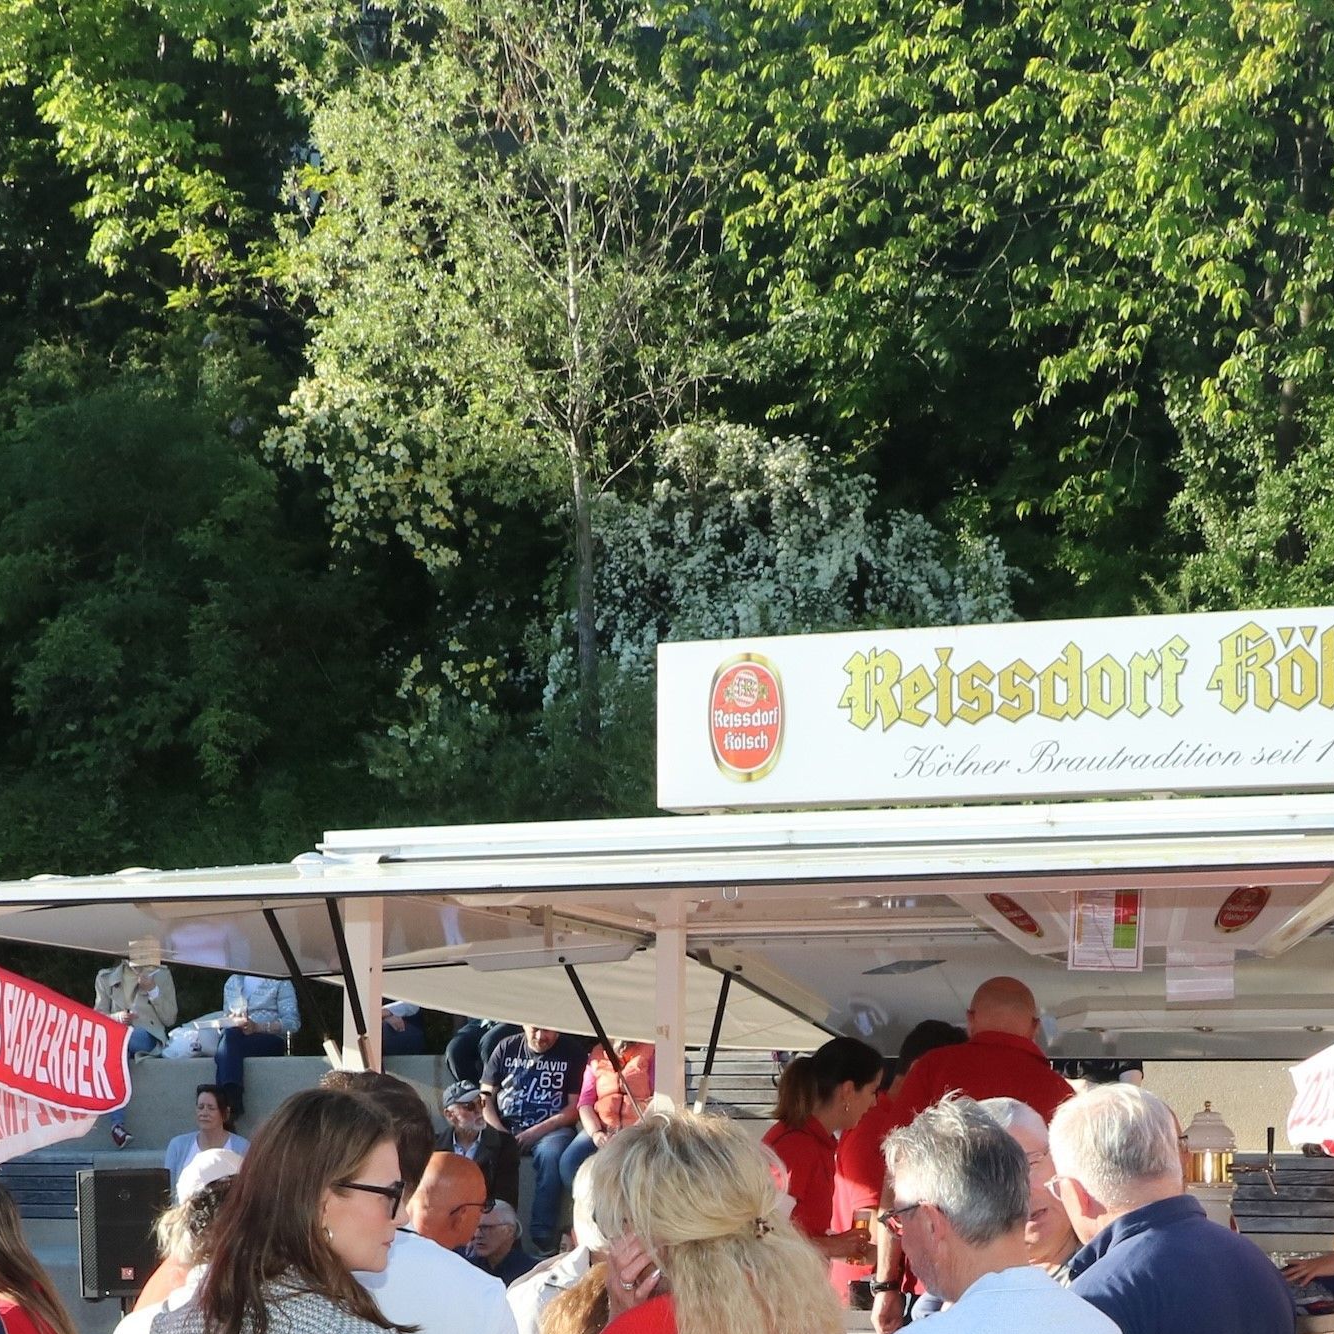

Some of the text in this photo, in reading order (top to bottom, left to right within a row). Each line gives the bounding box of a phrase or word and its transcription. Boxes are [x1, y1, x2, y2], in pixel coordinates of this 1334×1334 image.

[837, 634, 1190, 732] Reissdorf
[714, 707, 779, 728] Reissdorf
[724, 730, 768, 750] Kölsch
[893, 743, 1010, 779] Kölner
[1017, 739, 1245, 774] Brautradition
[1250, 738, 1314, 766] seit
[504, 1057, 568, 1072] CAMP DAVID
[539, 1071, 565, 1090] 63
